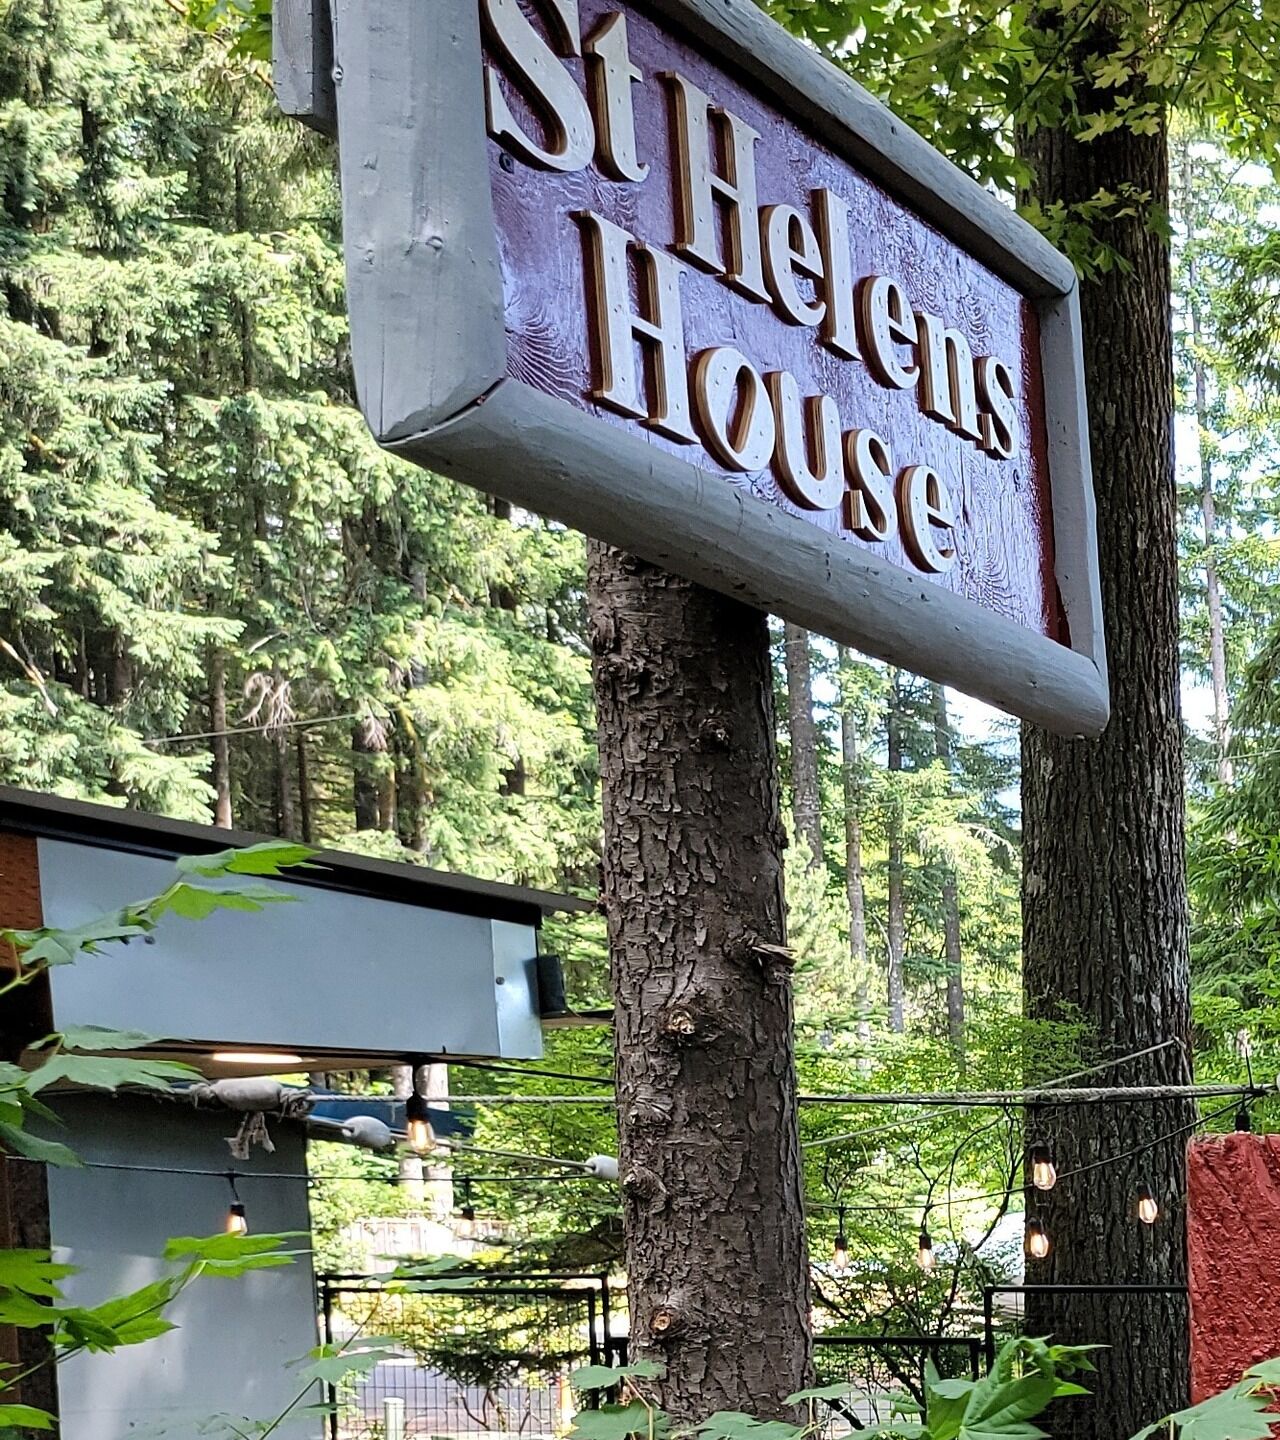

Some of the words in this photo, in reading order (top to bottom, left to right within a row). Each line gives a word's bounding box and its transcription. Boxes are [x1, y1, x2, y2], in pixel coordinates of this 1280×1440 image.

[481, 0, 650, 182] St
[660, 71, 1019, 461] Helens
[573, 210, 957, 574] House
